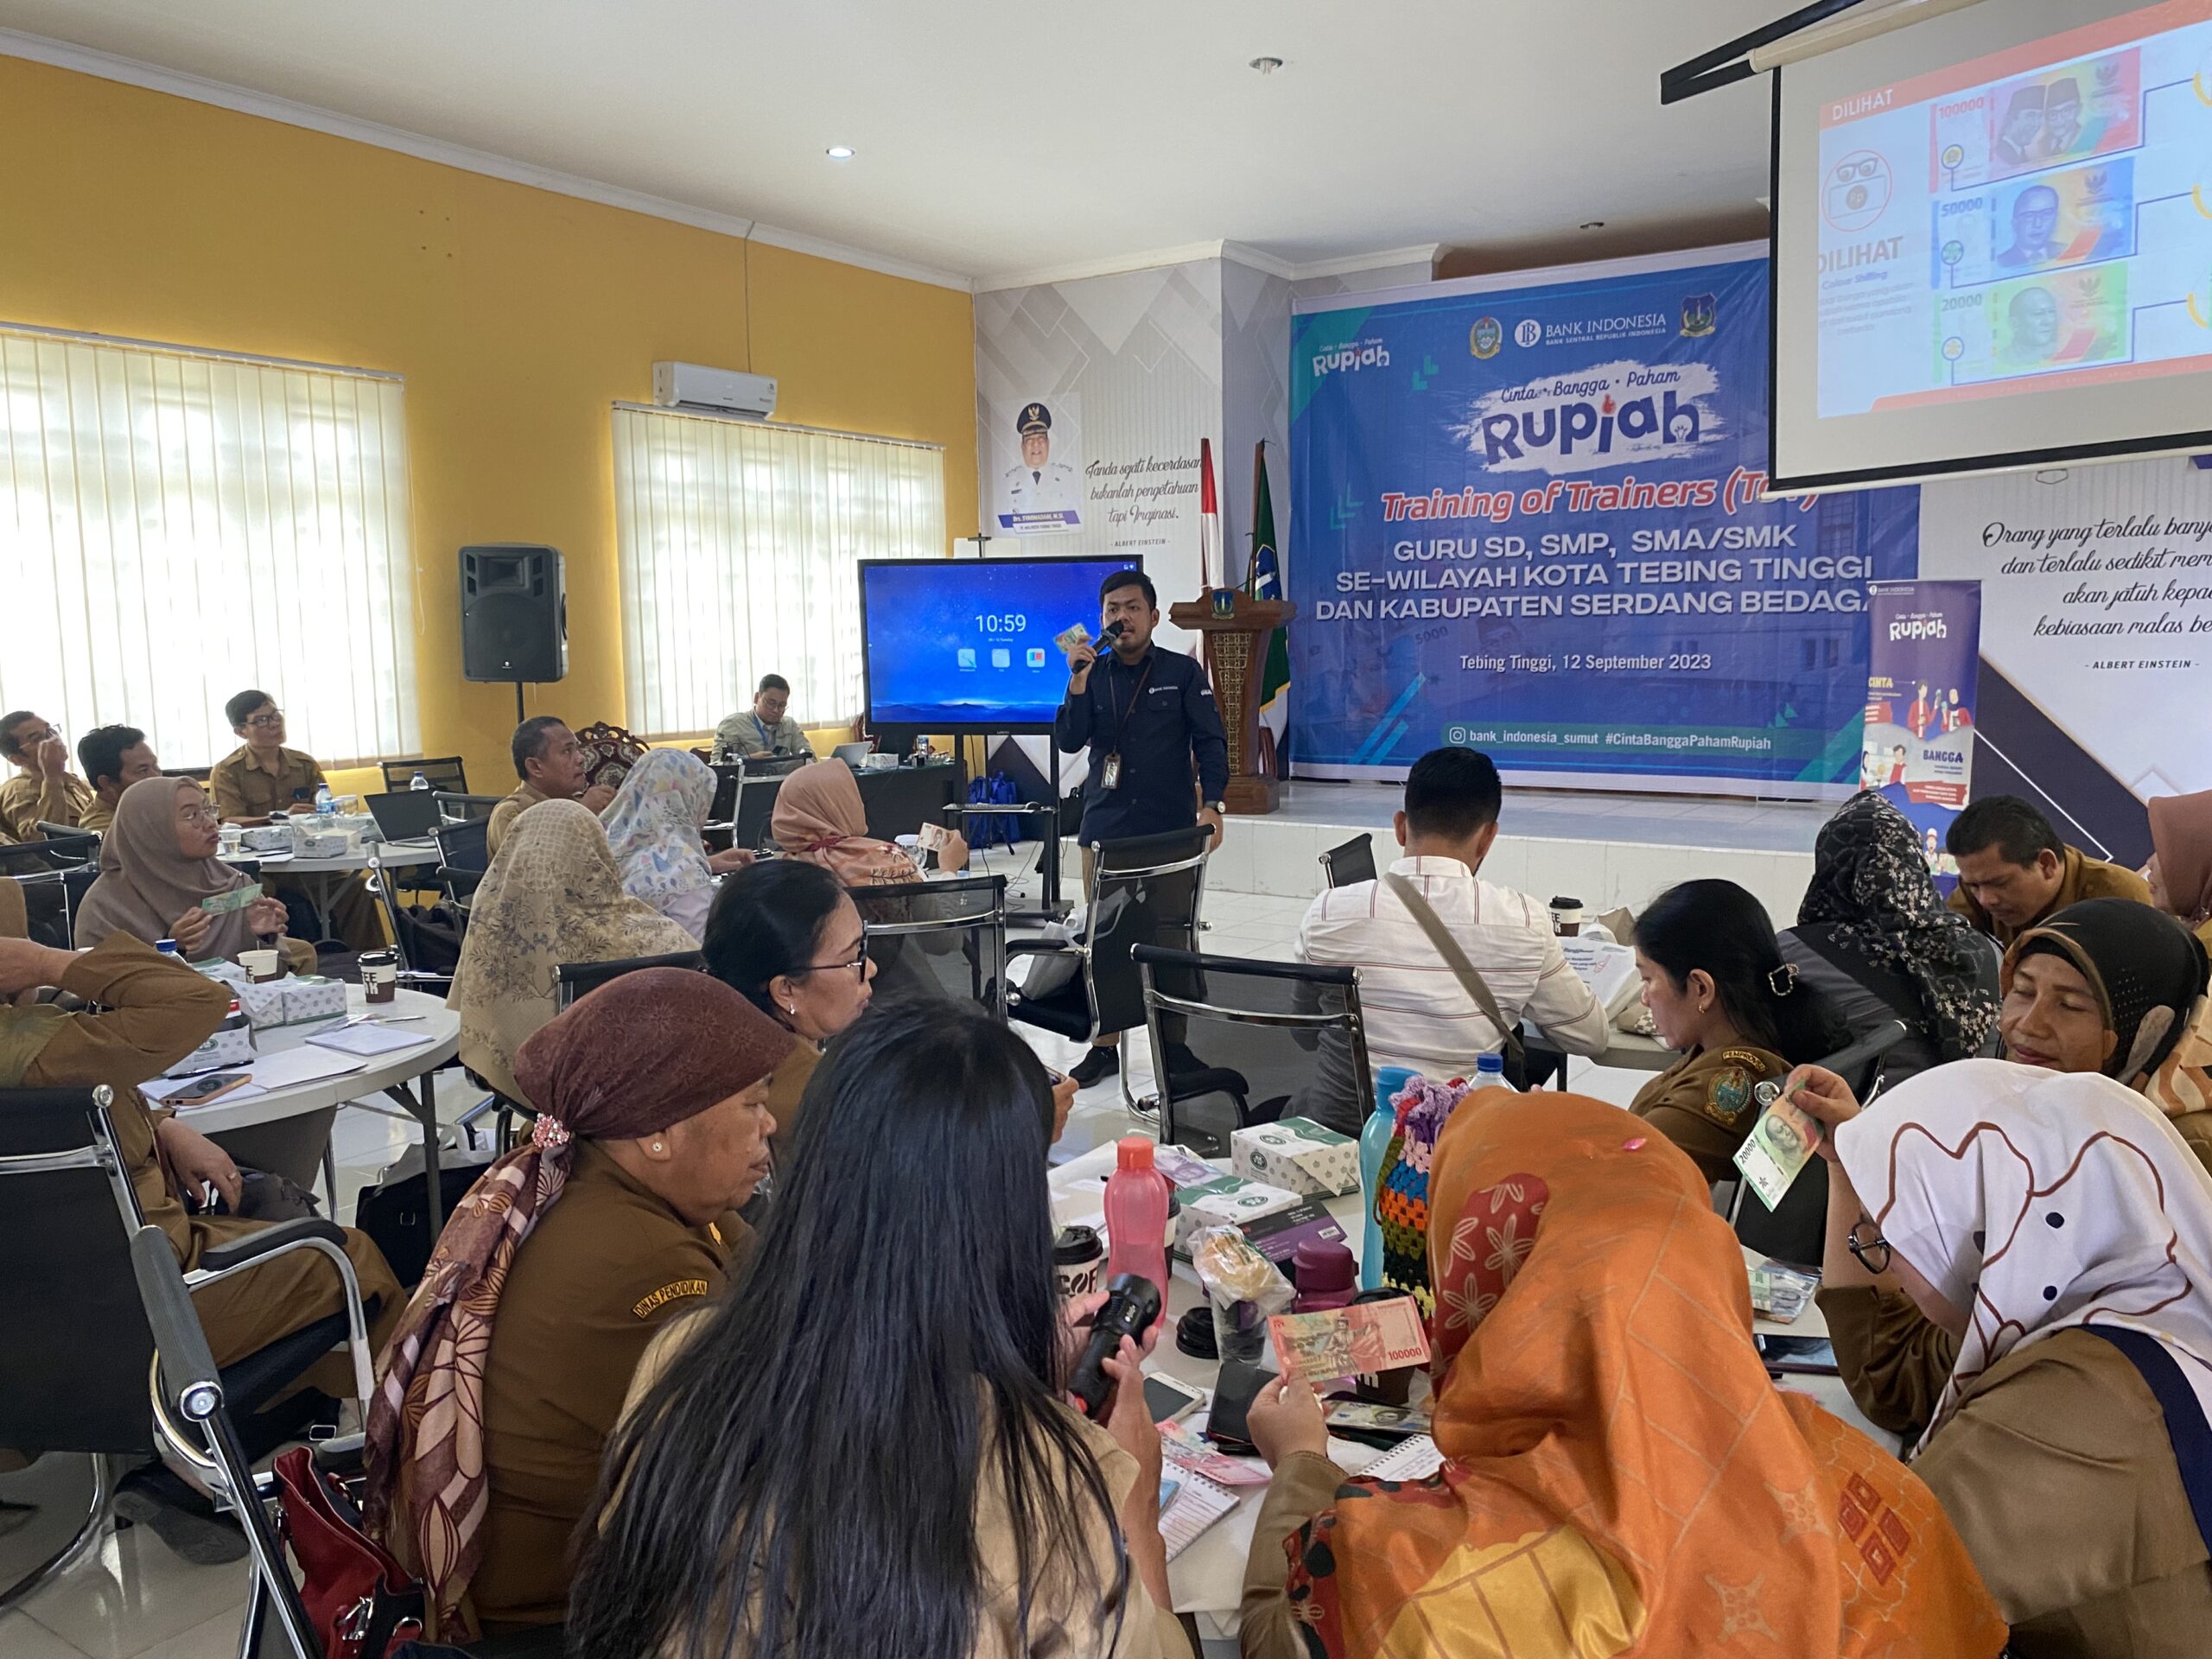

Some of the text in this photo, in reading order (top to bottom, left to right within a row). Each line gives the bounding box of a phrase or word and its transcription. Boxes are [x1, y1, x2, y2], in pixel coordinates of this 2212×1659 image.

[1832, 89, 1893, 120] DILIHAT
[1939, 97, 1985, 118] 100000
[1942, 197, 1983, 218] 50000
[1941, 293, 1982, 312] 20000
[1546, 321, 1582, 338] BANK
[1587, 314, 1666, 334] INDONESIA
[1566, 334, 1593, 344] SENTRAL
[1596, 332, 1626, 341] REPUBLIK
[1628, 327, 1666, 337] INDONESIA
[1501, 370, 1681, 403] Cinta Bangga Paham
[1482, 390, 1700, 466] Rupiah
[1085, 460, 1117, 479] Tanda
[1090, 480, 1198, 502] bukanlah pengetahuan
[1382, 486, 1514, 523] Training
[1520, 480, 1566, 515] of
[1566, 475, 1718, 513] Trainers
[1108, 507, 1128, 527] tapi
[1394, 524, 1797, 562] GURU SD, SMP, SMA/SMK
[1983, 522, 2044, 550] Orang
[2046, 529, 2092, 548] yang
[2094, 514, 2160, 538] terlalu
[2001, 556, 2035, 574] dan
[2037, 550, 2101, 573] terlalu
[2106, 547, 2176, 570] sedikit
[1336, 556, 1872, 592] SE-WILAYAH KOTA TEBING TINGGI
[1316, 600, 1373, 620] DAN
[1380, 595, 1562, 620] KABUPATEN
[1570, 591, 1732, 616] SERDANG
[2063, 582, 2109, 604] akan
[2105, 582, 2158, 611] jatuh
[976, 614, 1027, 632] 10:59
[2033, 614, 2123, 636] kebiasaan
[2127, 612, 2183, 634] malas
[1460, 654, 1711, 672] Tebing Tinggi, 12 September 2023
[2092, 660, 2192, 670] ALBERT EINSTEIN
[1868, 677, 1893, 689] CINTA
[1470, 730, 1771, 751] bank_indonesia_sumut #CintaBanggaPahamRupiah
[1923, 749, 1963, 764] BANGGA
[1738, 1139, 1756, 1164] 20000
[635, 1280, 707, 1319] DINAS PENDIDIKAN
[1388, 1347, 1422, 1361] 100000
